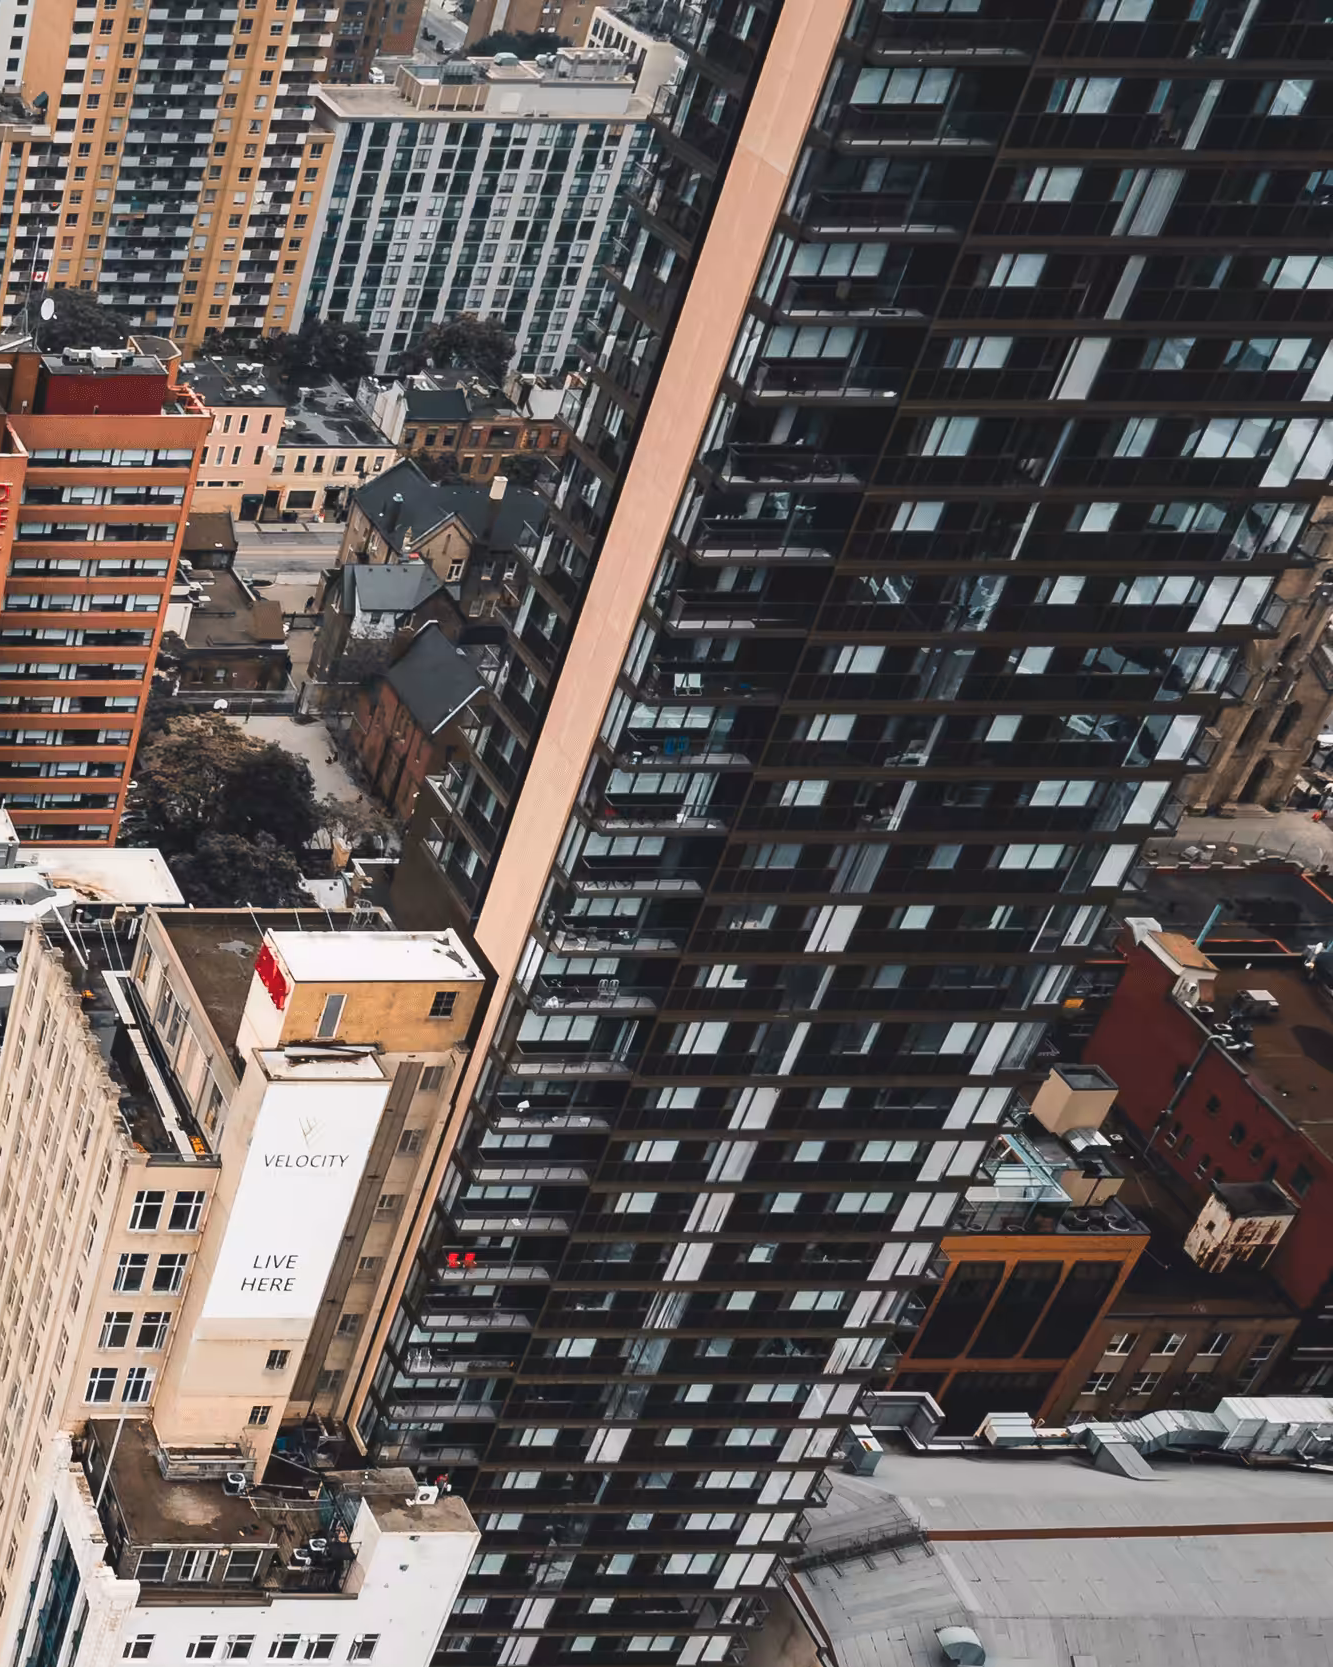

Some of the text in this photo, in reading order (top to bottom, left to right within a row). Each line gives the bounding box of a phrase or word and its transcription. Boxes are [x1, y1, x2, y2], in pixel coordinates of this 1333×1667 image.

[264, 1154, 350, 1168] VELOCITY
[253, 1255, 299, 1269] LIVE
[240, 1277, 296, 1291] HERE
